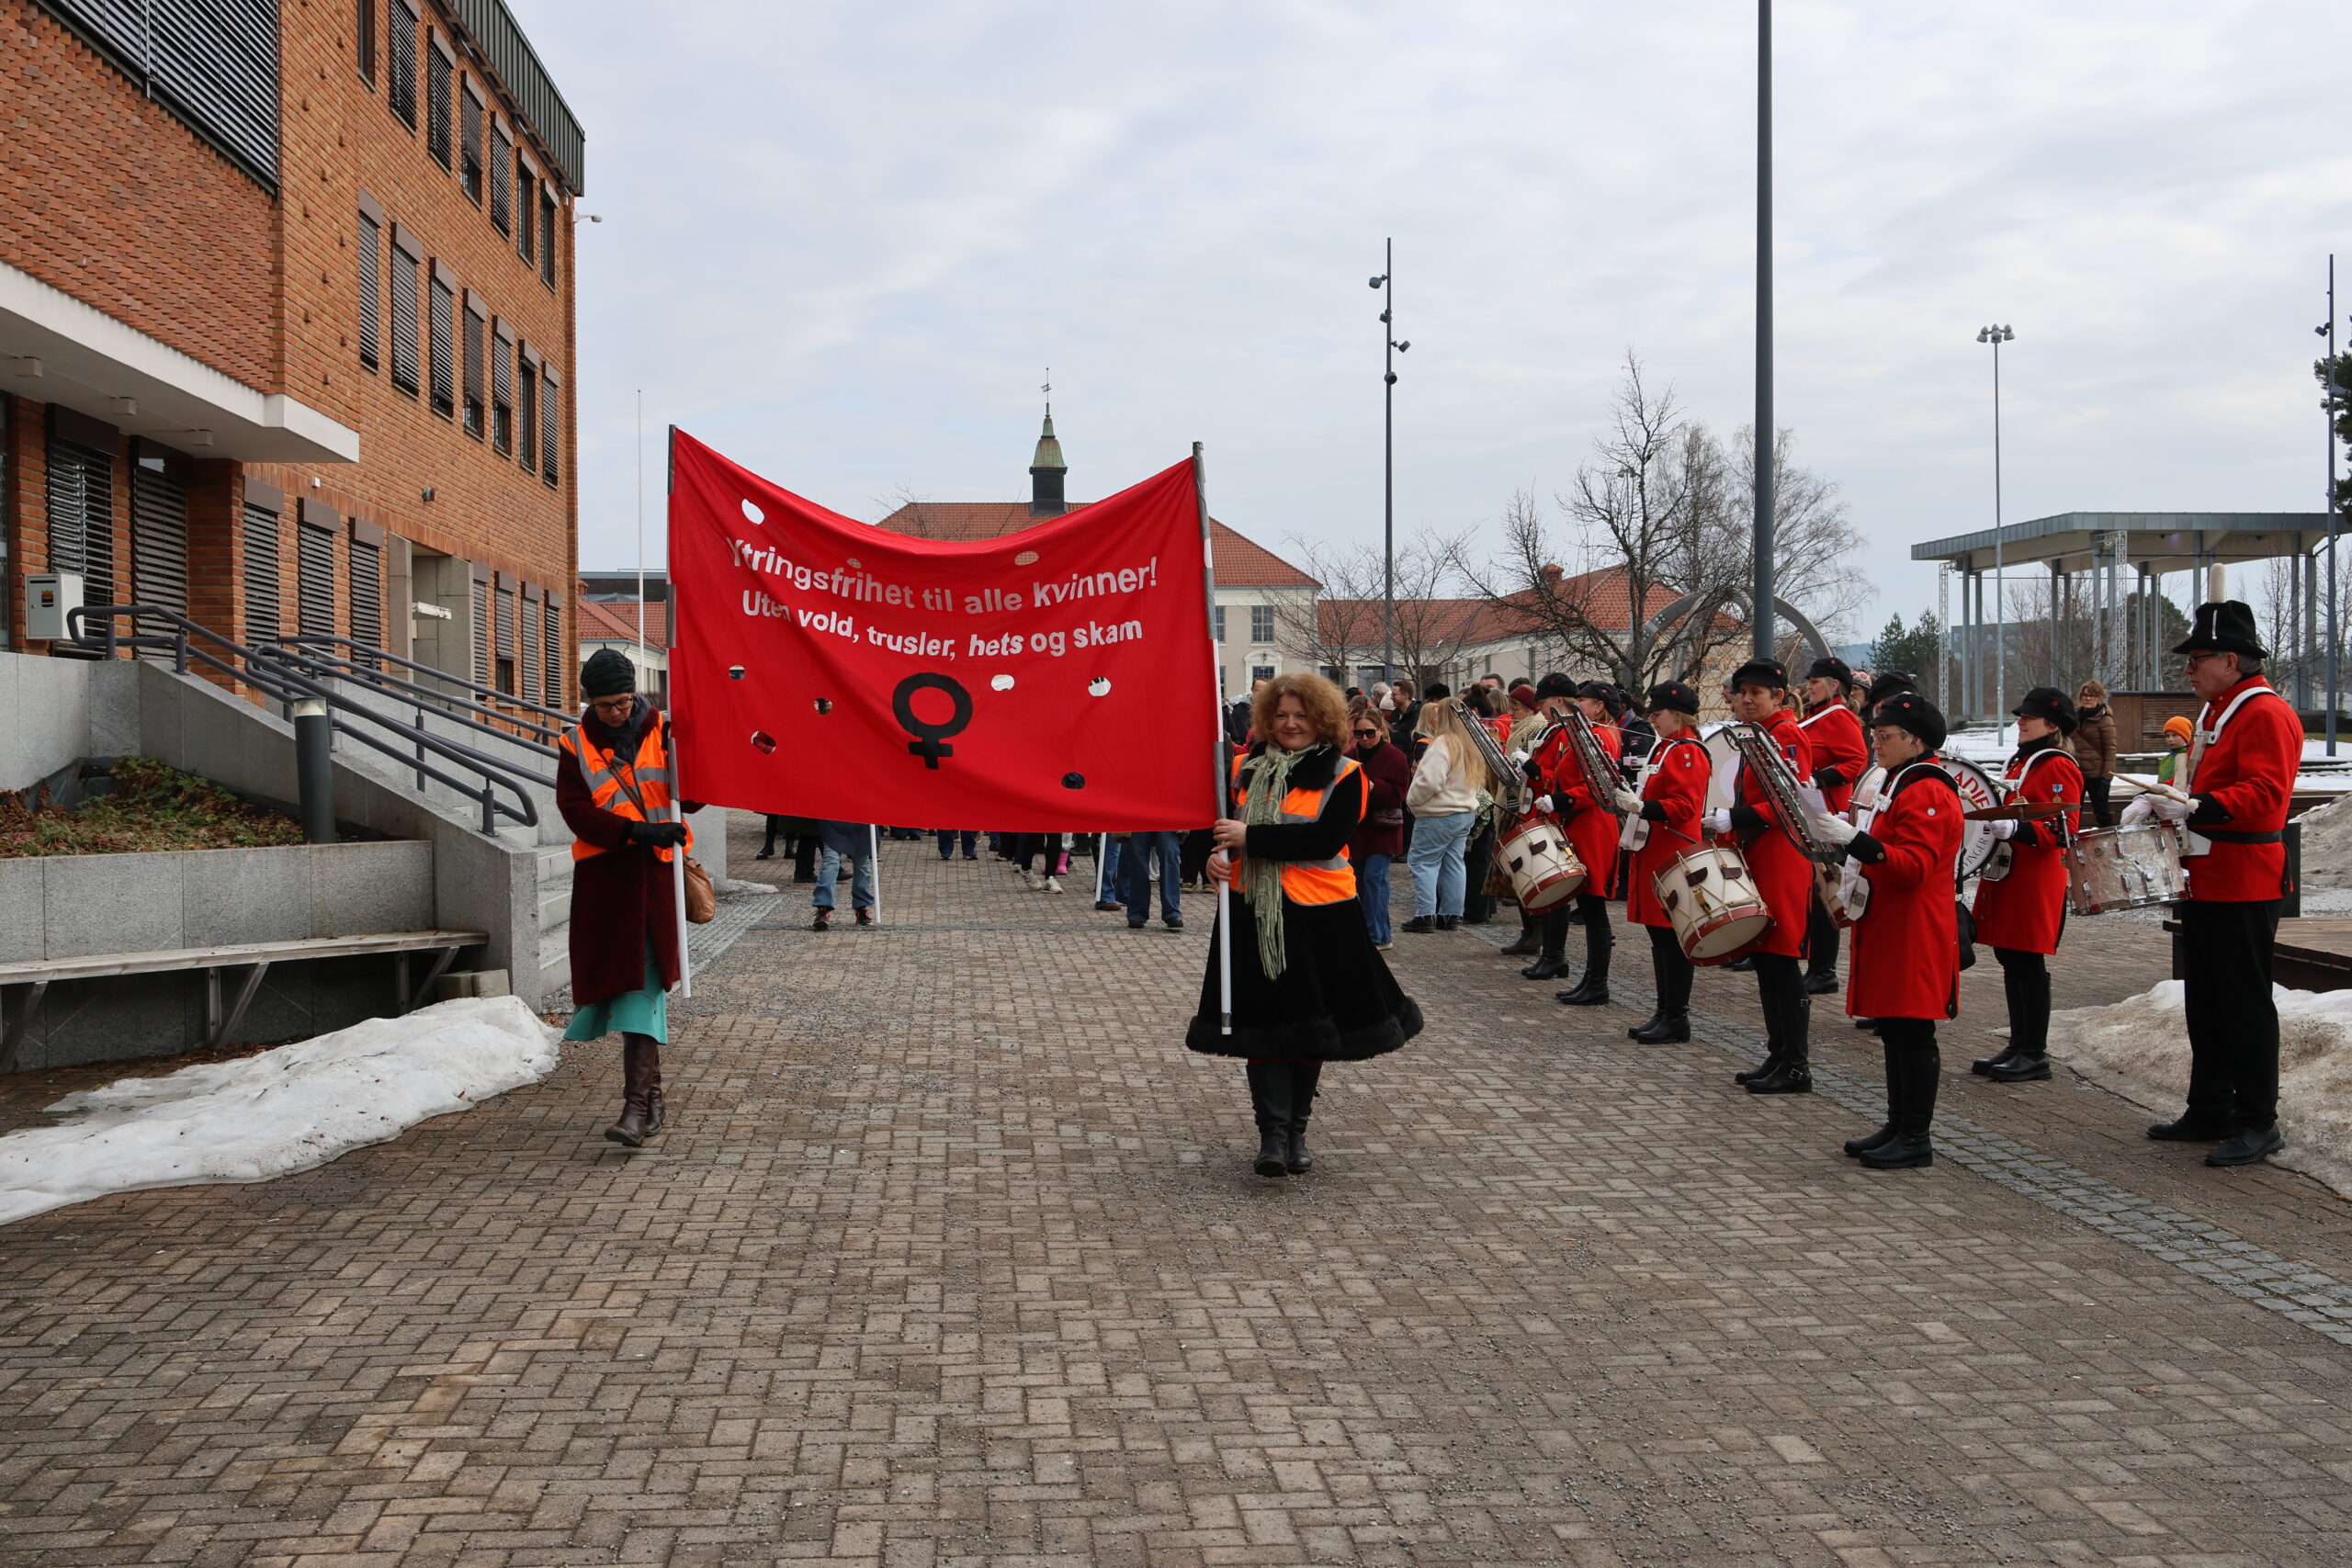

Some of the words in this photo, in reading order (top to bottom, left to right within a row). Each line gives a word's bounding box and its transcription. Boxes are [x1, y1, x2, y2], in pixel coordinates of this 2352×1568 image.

[726, 536, 915, 609] Ytringsfrihet
[922, 588, 953, 612] til
[964, 588, 1023, 615] alle
[1033, 556, 1157, 607] kvinner!
[742, 590, 791, 622] Uten
[798, 609, 859, 643] vold,
[866, 626, 956, 661] trusler,
[968, 632, 1024, 657] hets
[1031, 631, 1066, 657] og
[1073, 620, 1142, 648] skam
